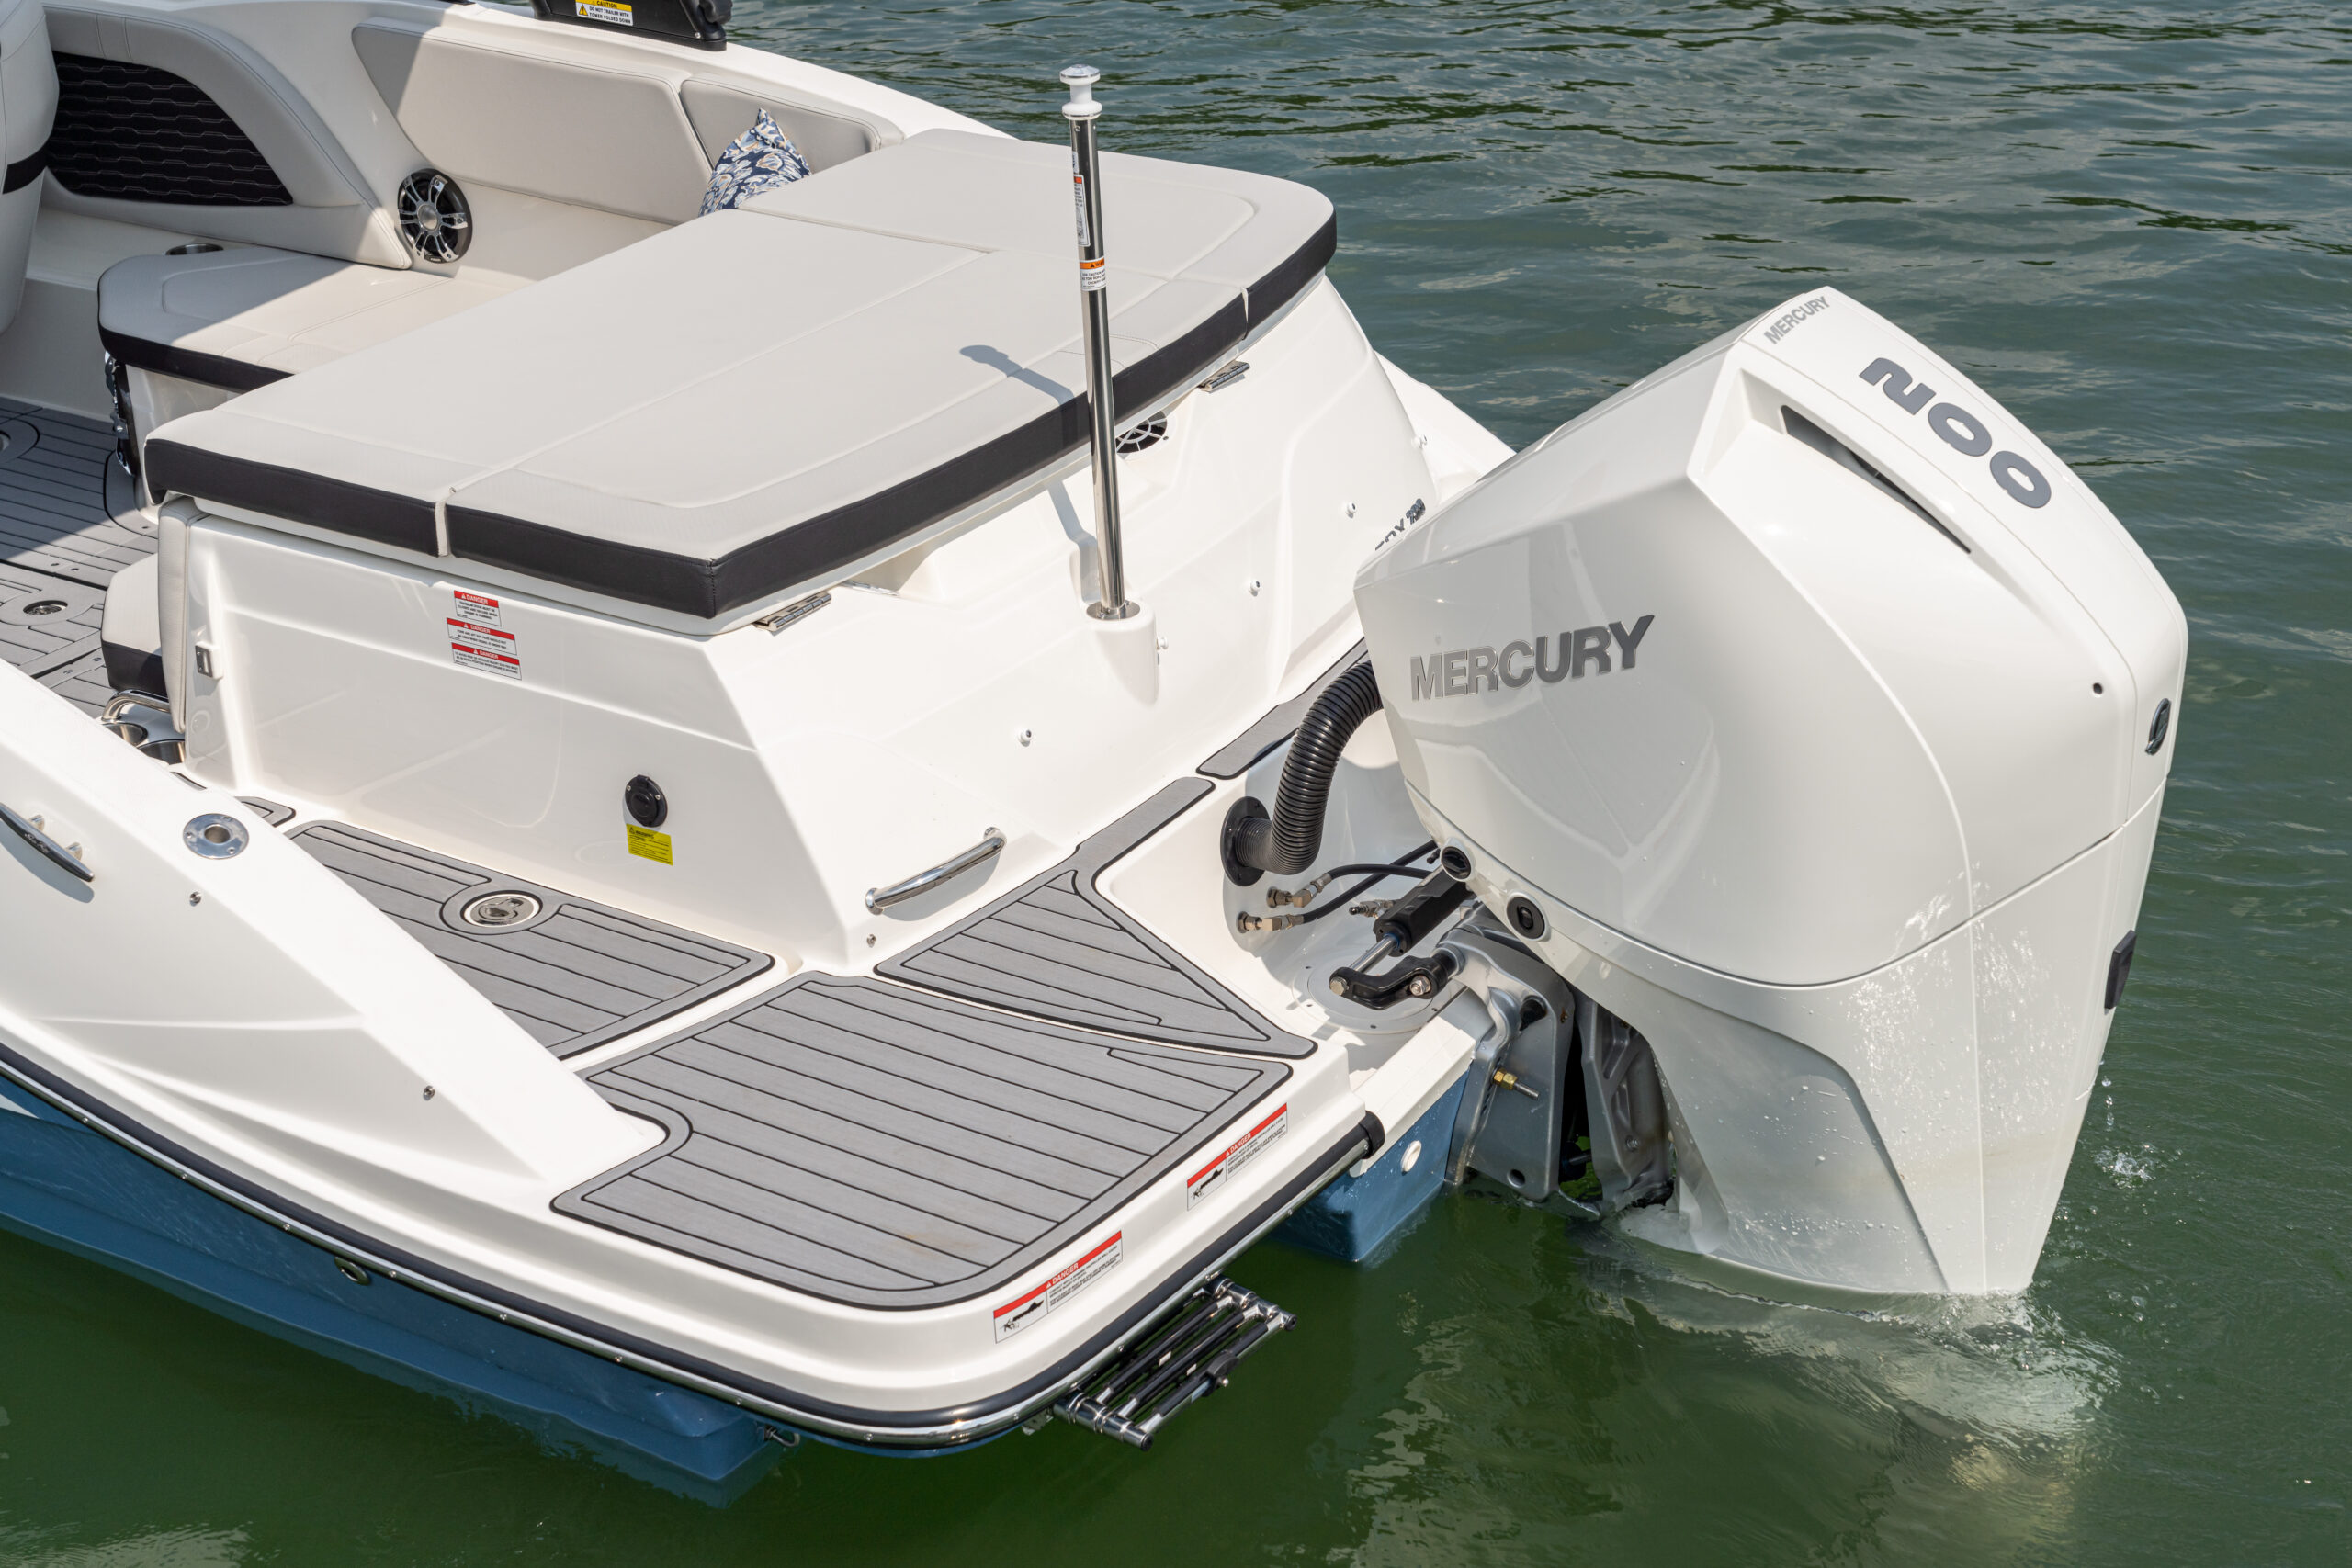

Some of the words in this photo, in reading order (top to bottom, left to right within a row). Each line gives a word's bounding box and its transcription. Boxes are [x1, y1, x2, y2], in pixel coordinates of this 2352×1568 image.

[1764, 296, 1830, 344] MERCURY
[1859, 357, 2052, 509] 200
[467, 595, 489, 604] DANGER
[470, 625, 491, 634] DANGER
[479, 650, 499, 660] DANGER
[1410, 615, 1655, 701] MERCURY
[1230, 1133, 1251, 1153] DANGER
[1052, 1262, 1079, 1284] DANGER
